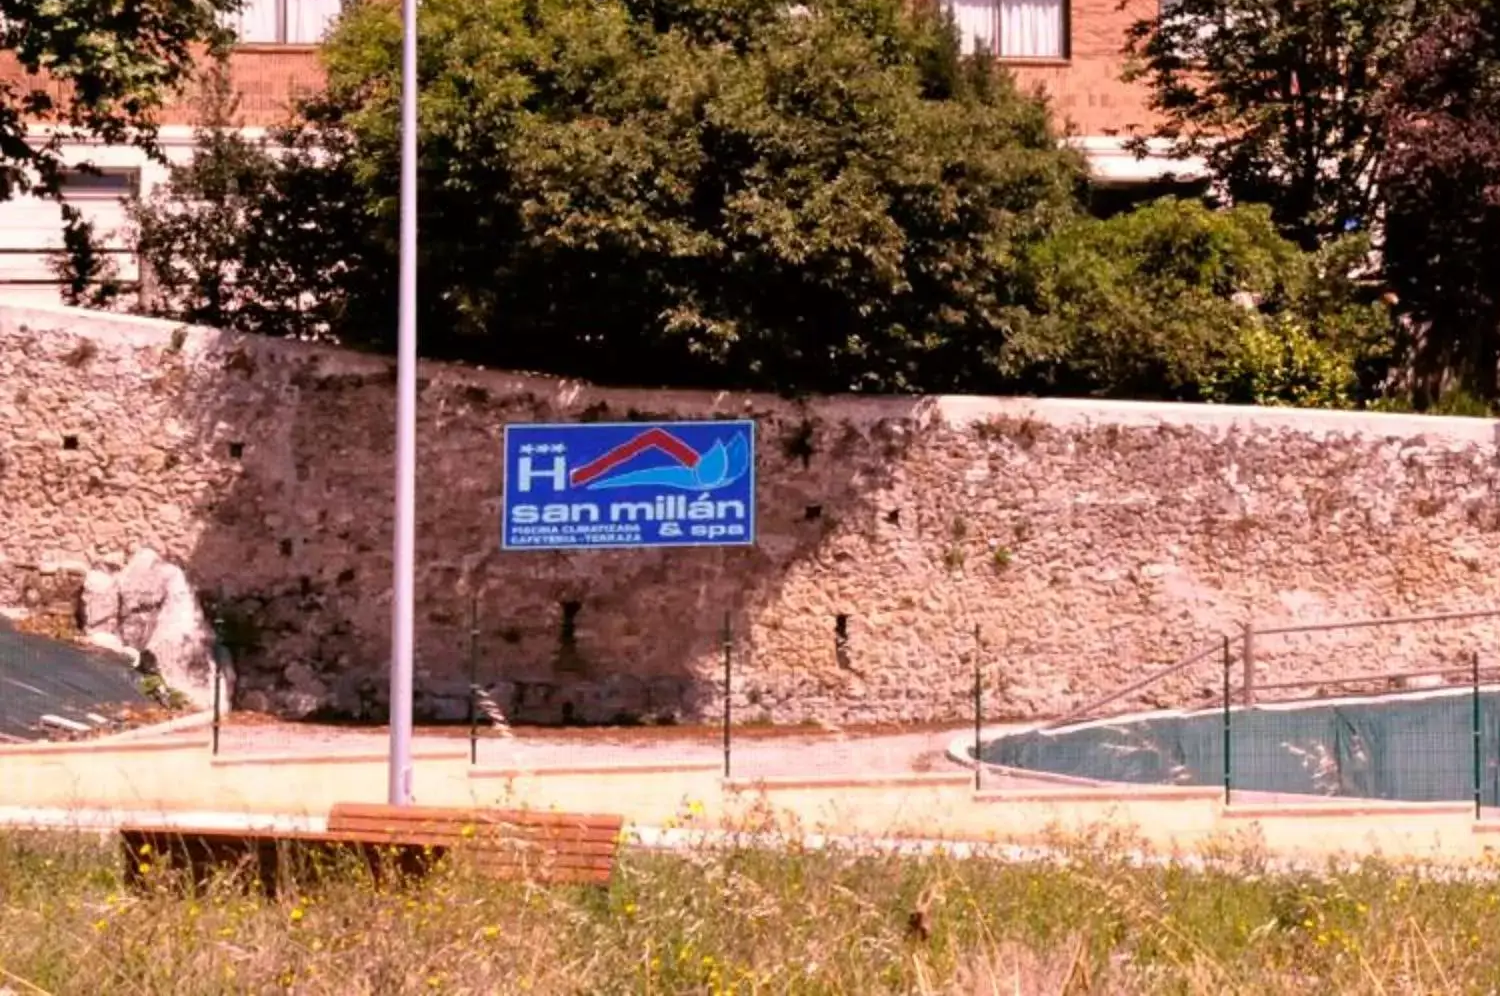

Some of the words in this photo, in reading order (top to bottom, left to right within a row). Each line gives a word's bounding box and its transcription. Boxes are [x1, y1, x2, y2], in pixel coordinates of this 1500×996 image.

[518, 456, 566, 492] H
[511, 503, 600, 523] san
[610, 492, 745, 521] millán
[659, 522, 683, 536] &
[690, 523, 745, 539] spa
